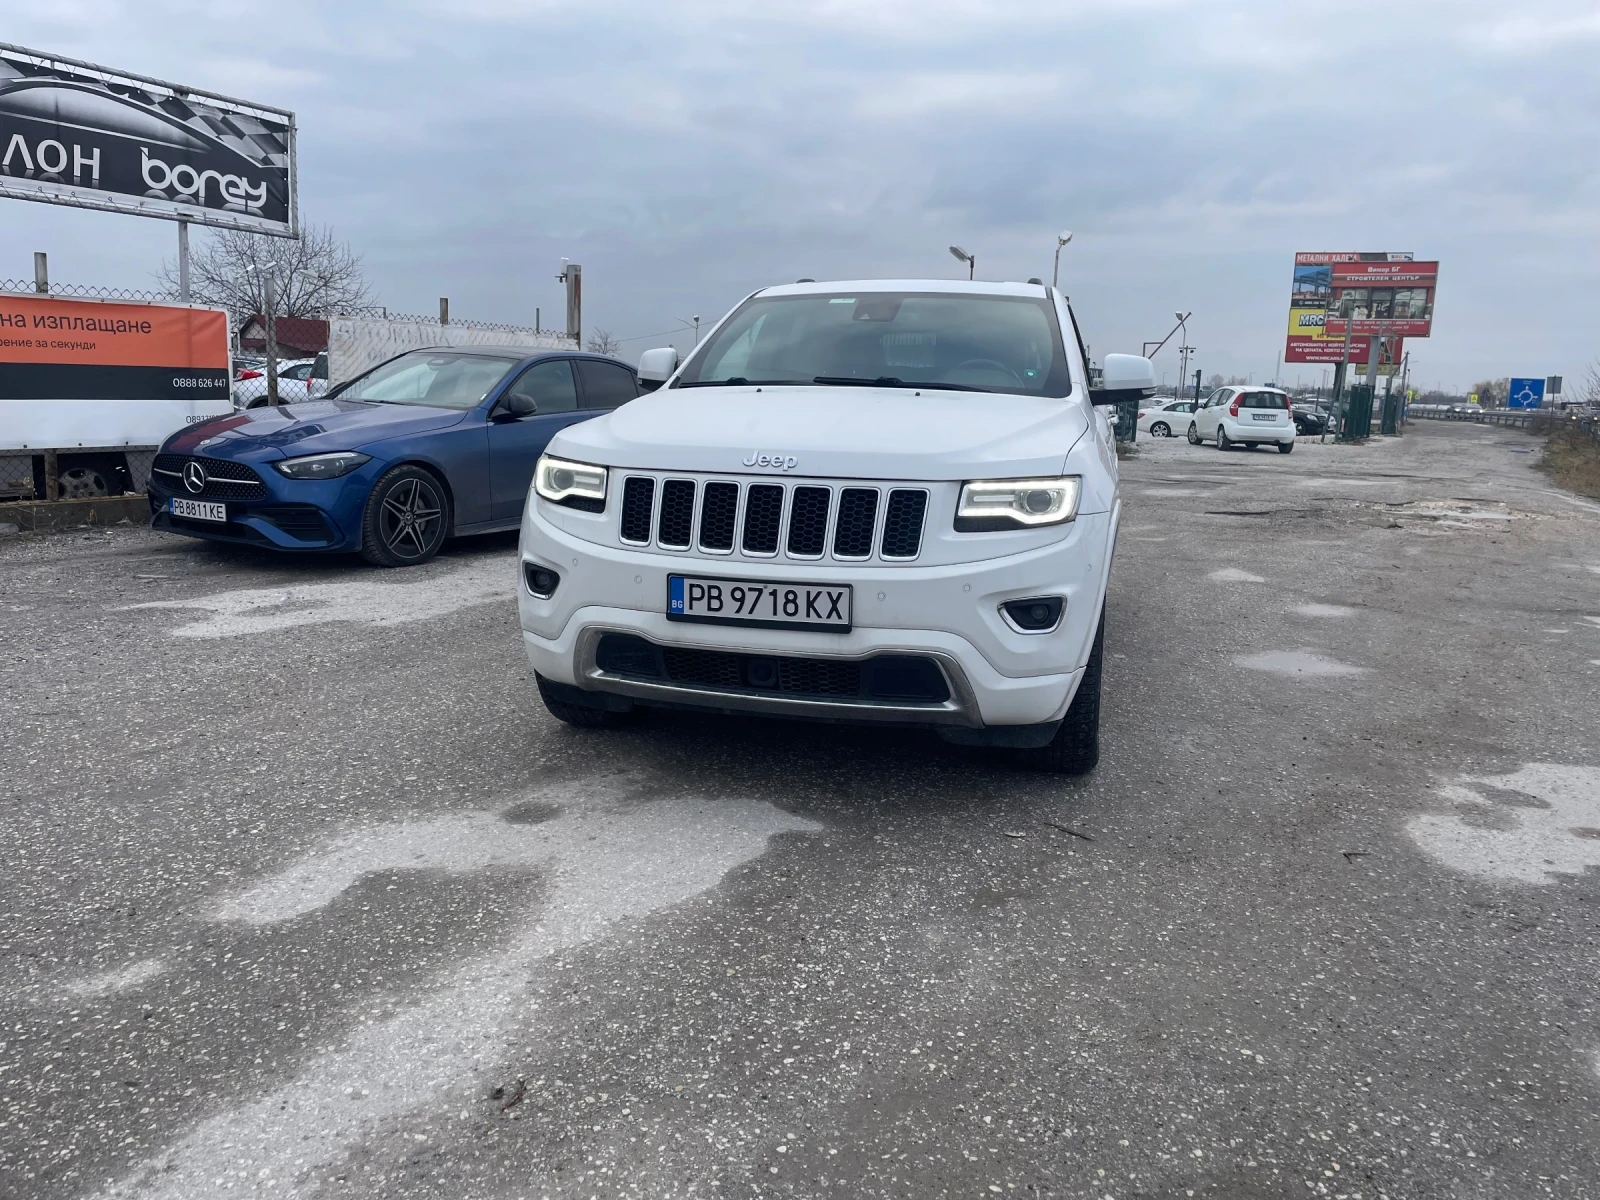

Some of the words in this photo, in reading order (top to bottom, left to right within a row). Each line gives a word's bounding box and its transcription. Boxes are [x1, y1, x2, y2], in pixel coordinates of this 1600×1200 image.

[140, 146, 267, 208] borey
[1297, 253, 1329, 262] МЕТАЛНИ
[0, 313, 27, 328] на
[33, 314, 152, 335] изплащане
[35, 339, 48, 348] за
[50, 340, 96, 350] секунди
[172, 378, 197, 387] 0888
[198, 378, 213, 388] 626
[213, 378, 226, 388] 447
[742, 450, 798, 471] Jeep
[688, 583, 724, 612] PB
[730, 586, 799, 617] 9718
[805, 590, 844, 620] KX
